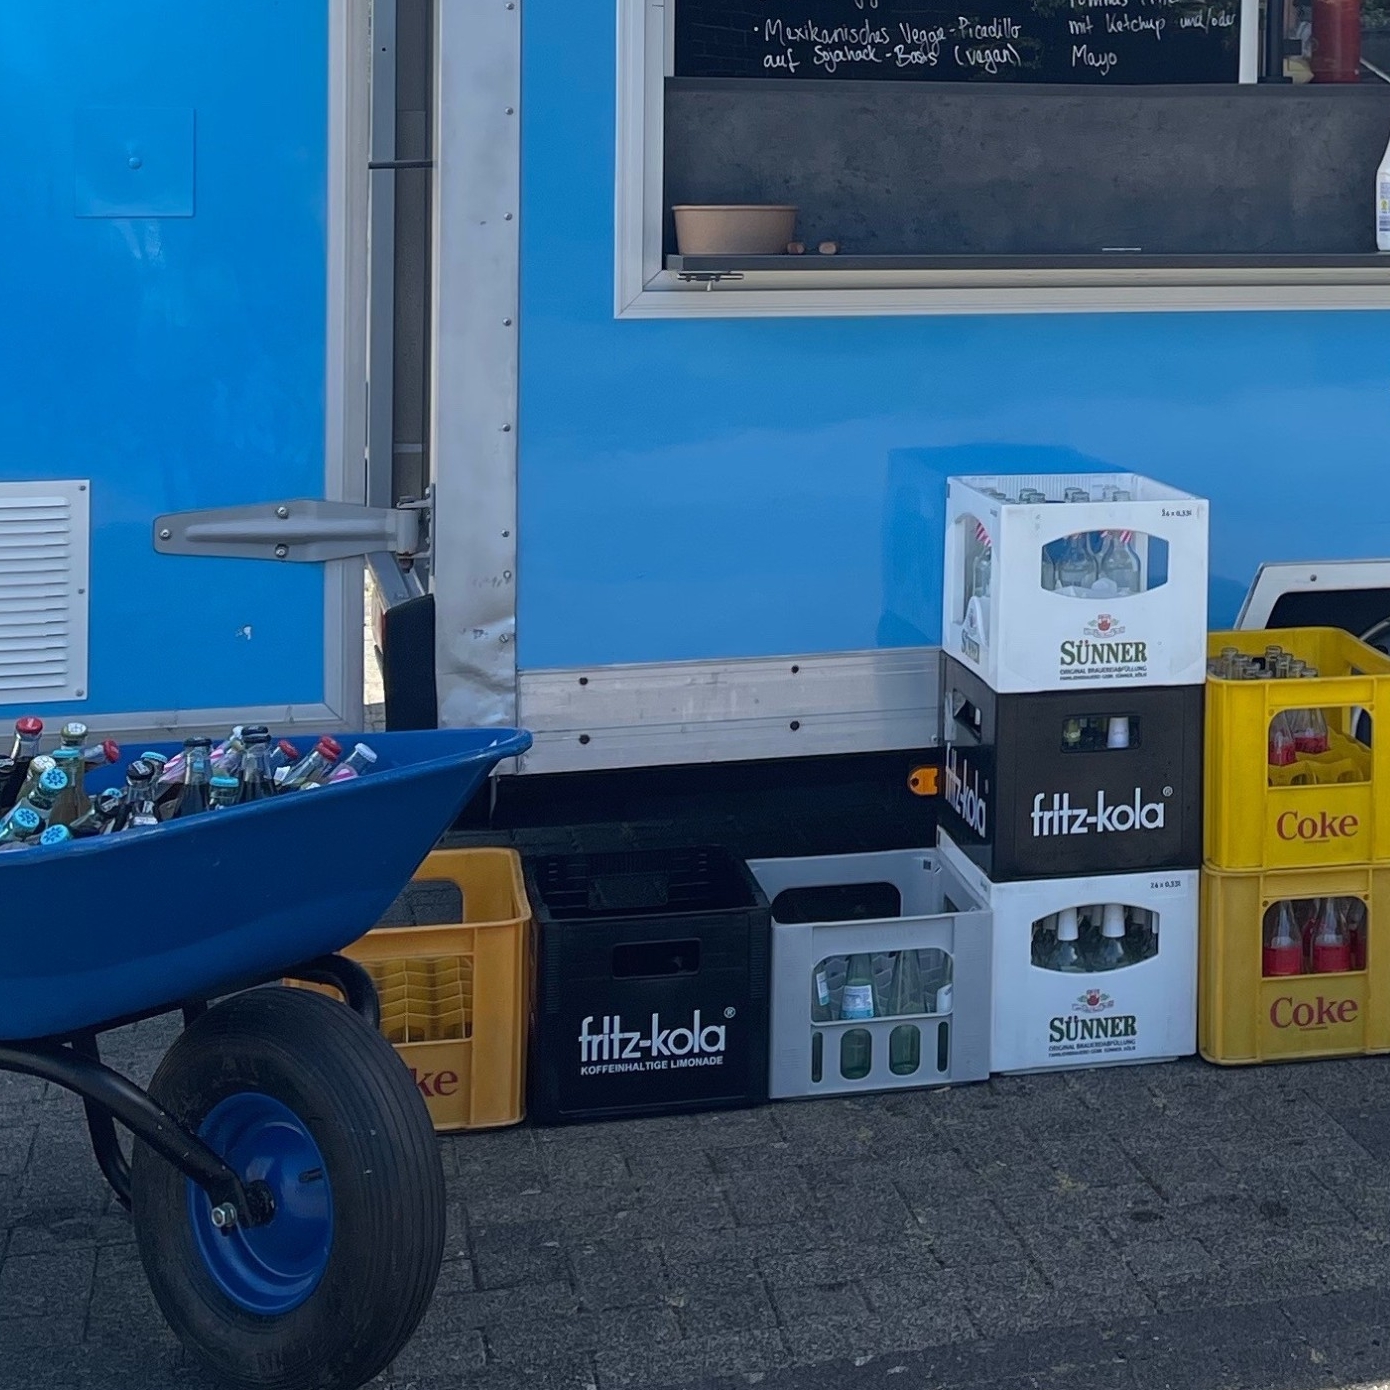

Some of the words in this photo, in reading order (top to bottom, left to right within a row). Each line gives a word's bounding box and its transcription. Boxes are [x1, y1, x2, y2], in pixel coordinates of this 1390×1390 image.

[764, 18, 891, 46] Mexikanisches
[1068, 14, 1095, 36] mit
[1105, 12, 1167, 41] Ketchup
[763, 48, 801, 74] auf
[953, 42, 1023, 74] (vegan)
[1071, 43, 1118, 77] Mayo
[1060, 639, 1148, 667] SÜNNER
[1276, 810, 1359, 841] Coke
[1270, 996, 1358, 1029] Coke
[1048, 1014, 1137, 1043] SÜNNER
[580, 1060, 668, 1076] KOFFEINHALTIGE
[670, 1055, 724, 1069] LIMONADE
[412, 1067, 458, 1098] ke
